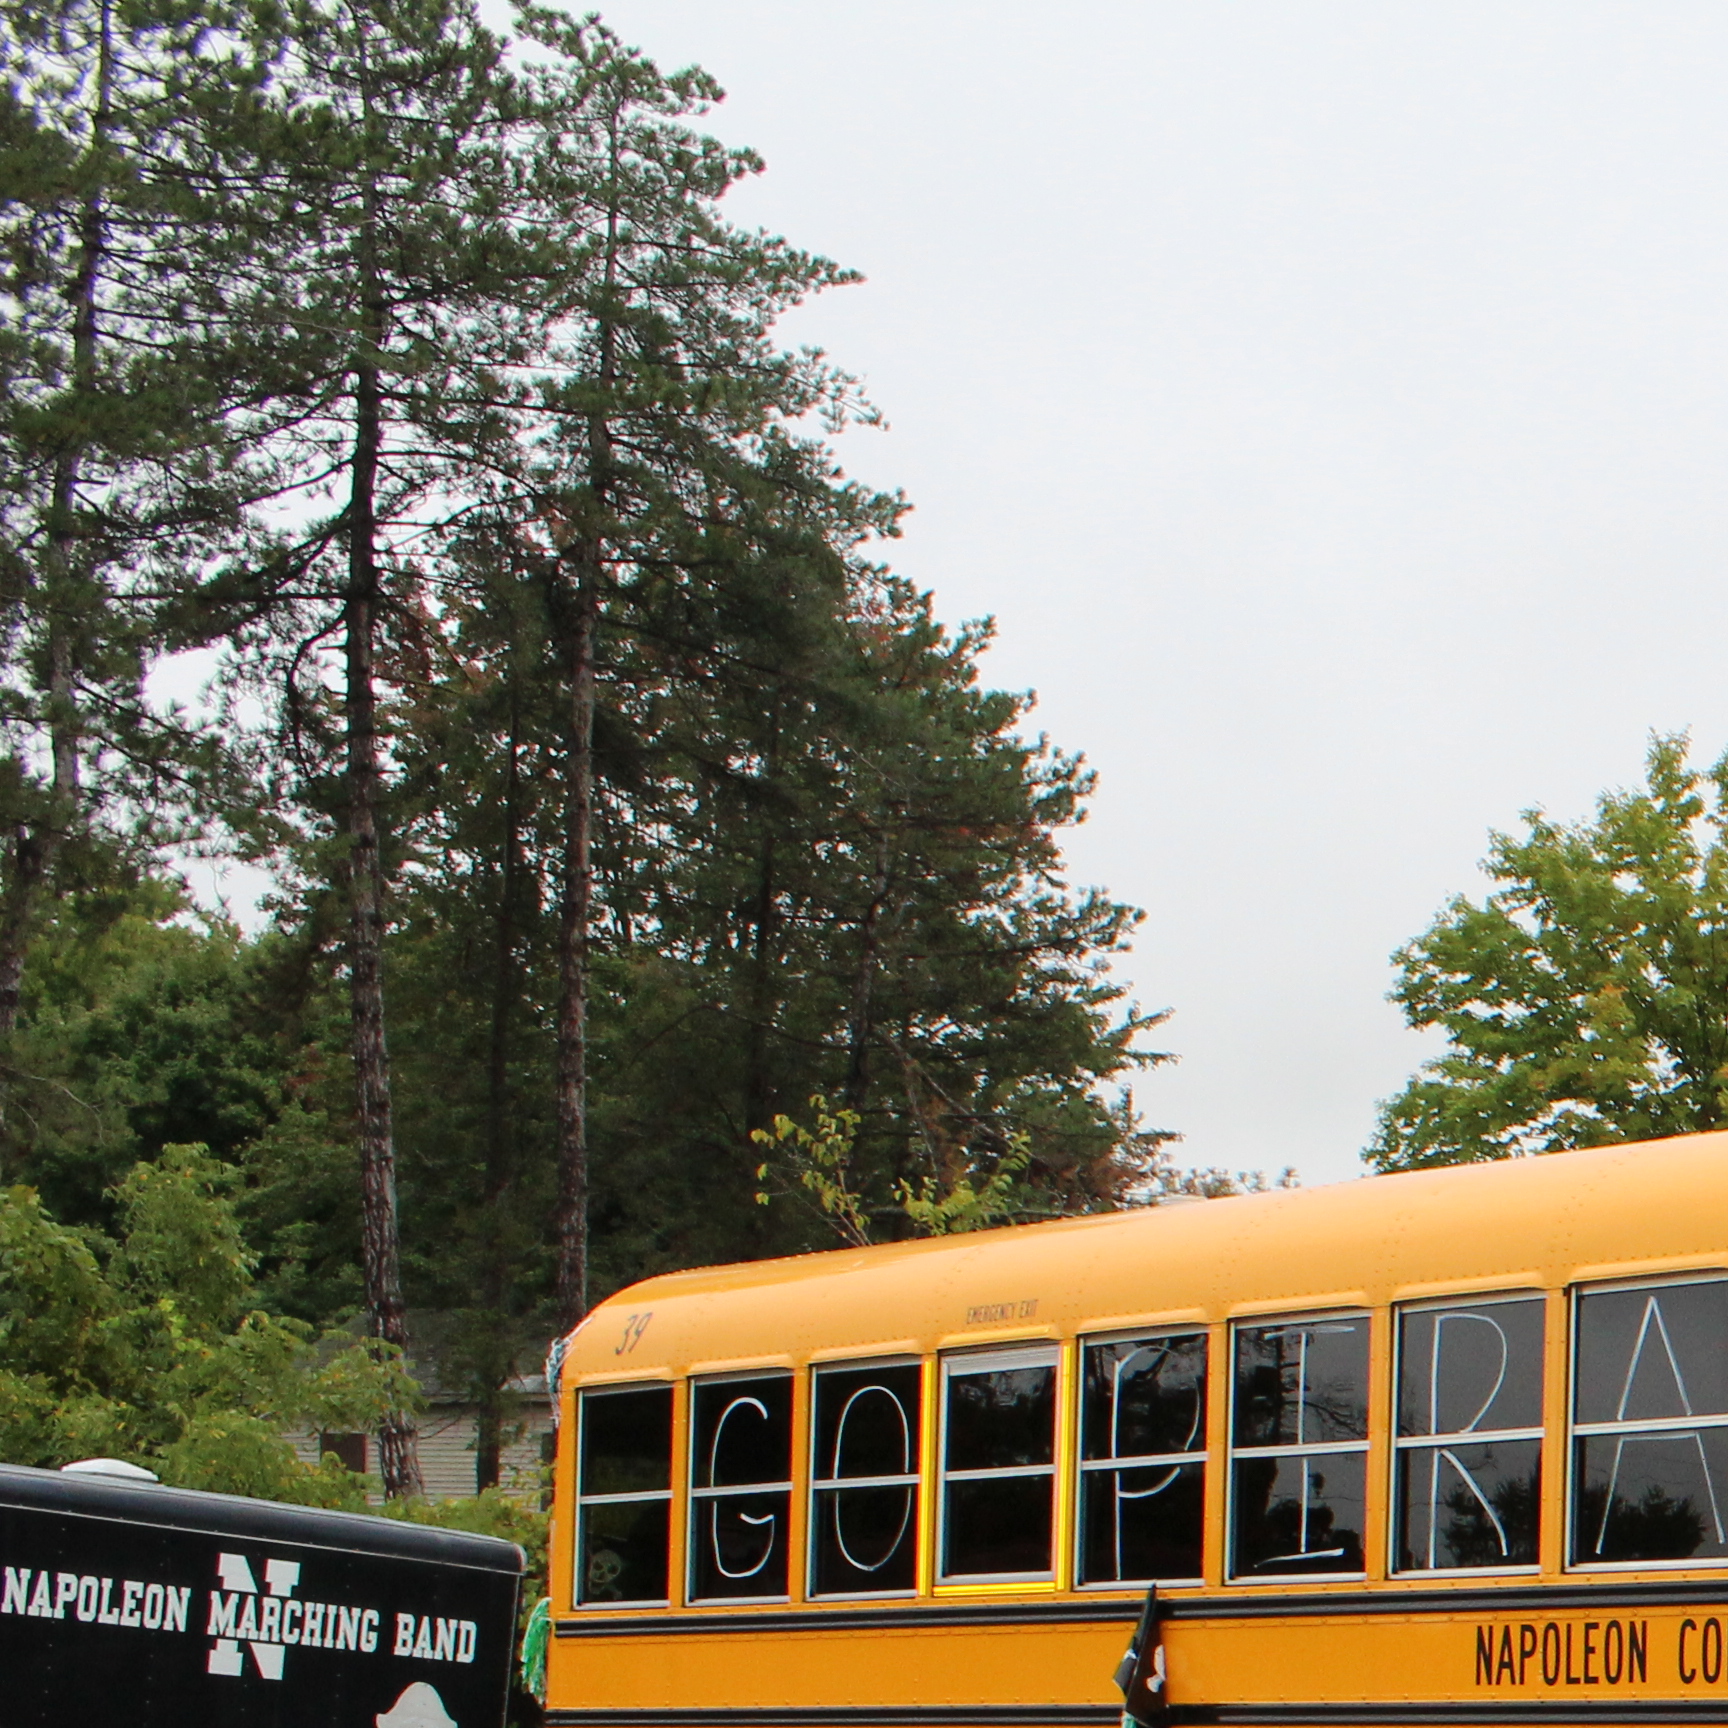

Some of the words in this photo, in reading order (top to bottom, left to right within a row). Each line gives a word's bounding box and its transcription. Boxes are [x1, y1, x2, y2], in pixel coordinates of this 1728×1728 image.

[615, 1312, 653, 1356] 39
[966, 1302, 1018, 1325] EMERGENCY
[1, 1566, 191, 1632] NAPOLEON
[206, 1591, 379, 1653] MARCHING
[393, 1612, 478, 1664] BAND
[1474, 1619, 1648, 1686] NAPOLEON
